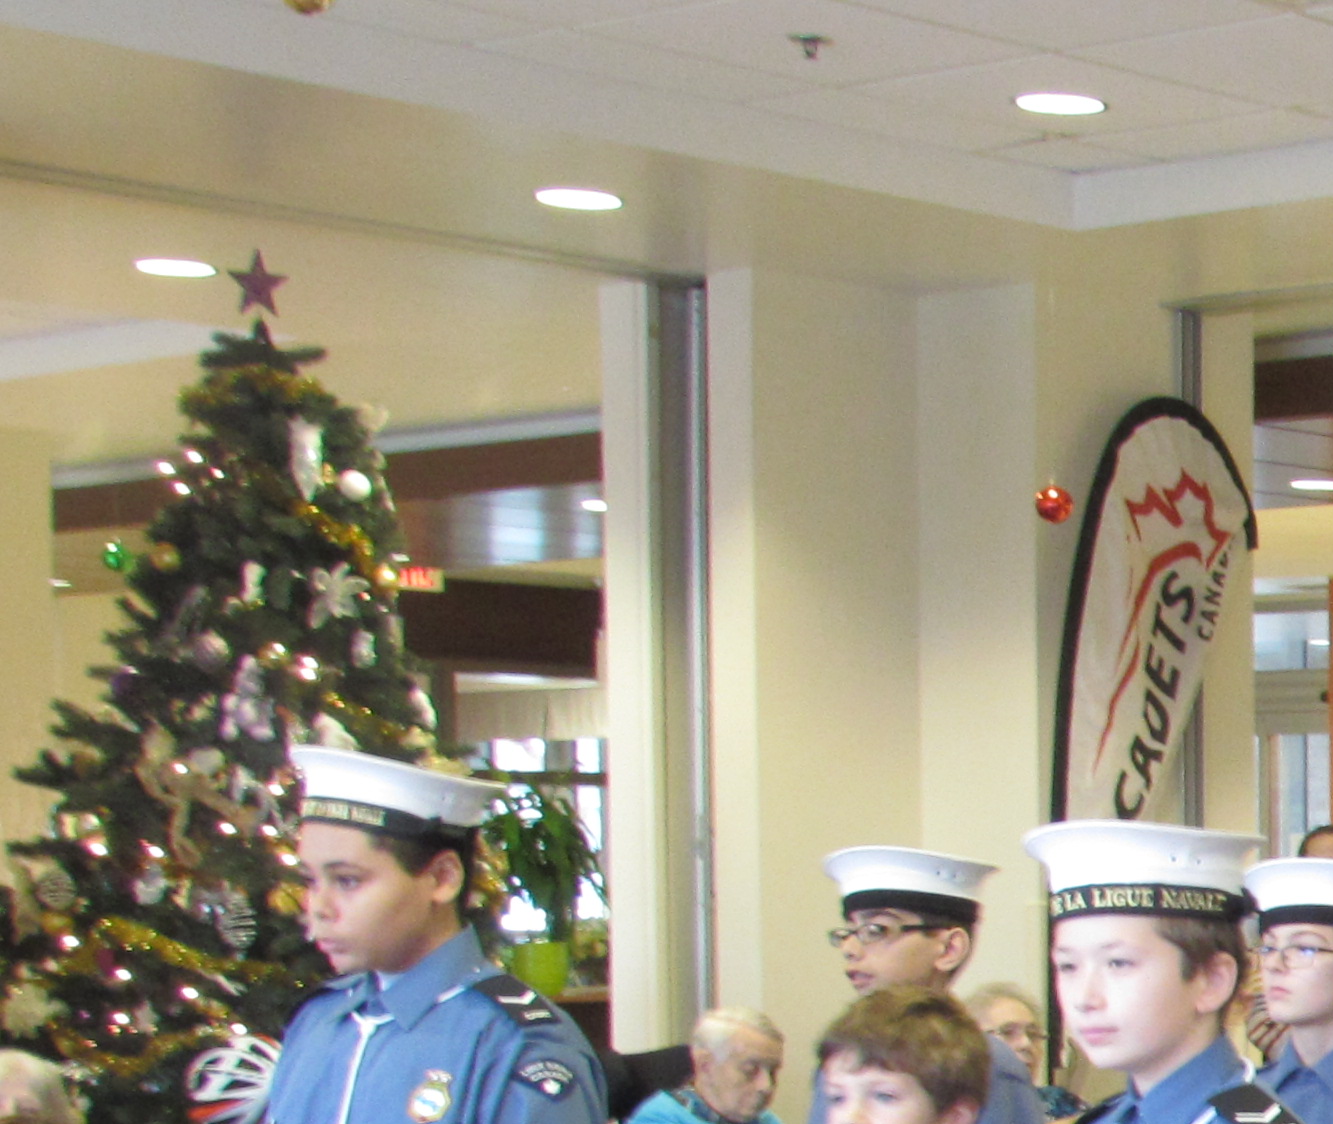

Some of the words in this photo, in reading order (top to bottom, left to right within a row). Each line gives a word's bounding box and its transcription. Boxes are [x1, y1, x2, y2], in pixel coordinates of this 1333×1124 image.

[1113, 569, 1195, 819] CADETS
[1065, 891, 1087, 912] LA
[1093, 886, 1154, 908] LIGUE
